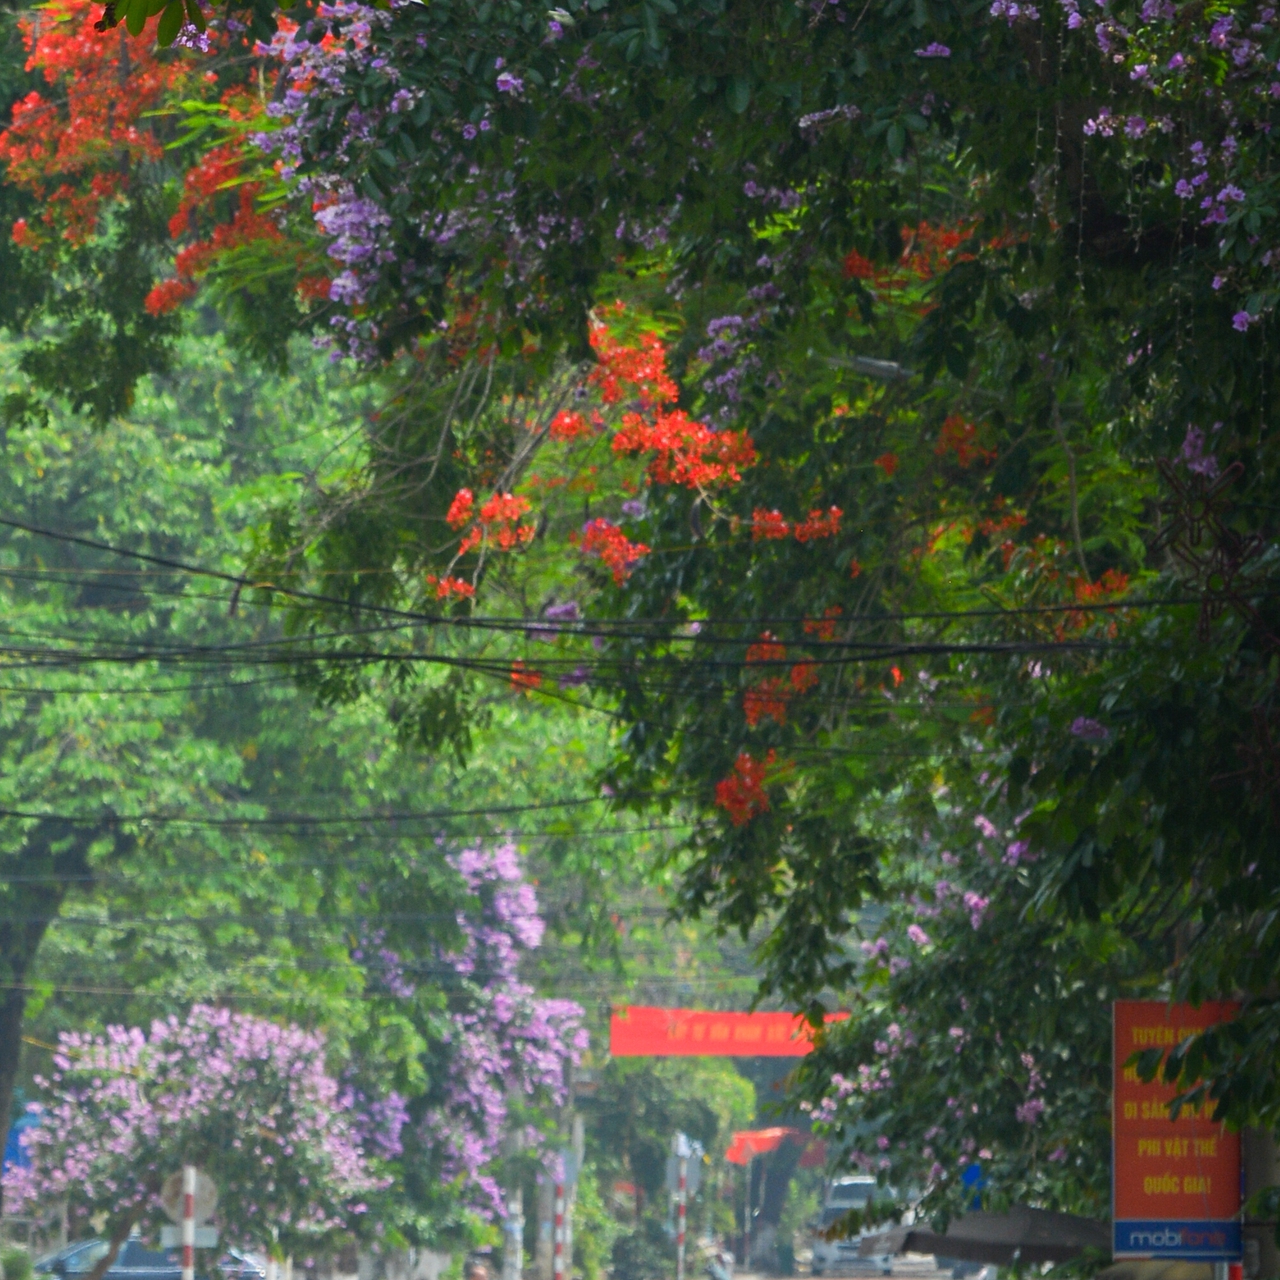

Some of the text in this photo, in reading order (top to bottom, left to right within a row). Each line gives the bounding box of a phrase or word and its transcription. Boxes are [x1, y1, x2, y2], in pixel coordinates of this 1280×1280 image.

[1133, 1026, 1174, 1045] TUYÊN
[1124, 1101, 1138, 1119] DI
[1138, 1138, 1160, 1157] PHI
[1164, 1136, 1188, 1160] VẬT
[1143, 1169, 1180, 1195] QUỐC
[1130, 1226, 1226, 1246] mobifone
